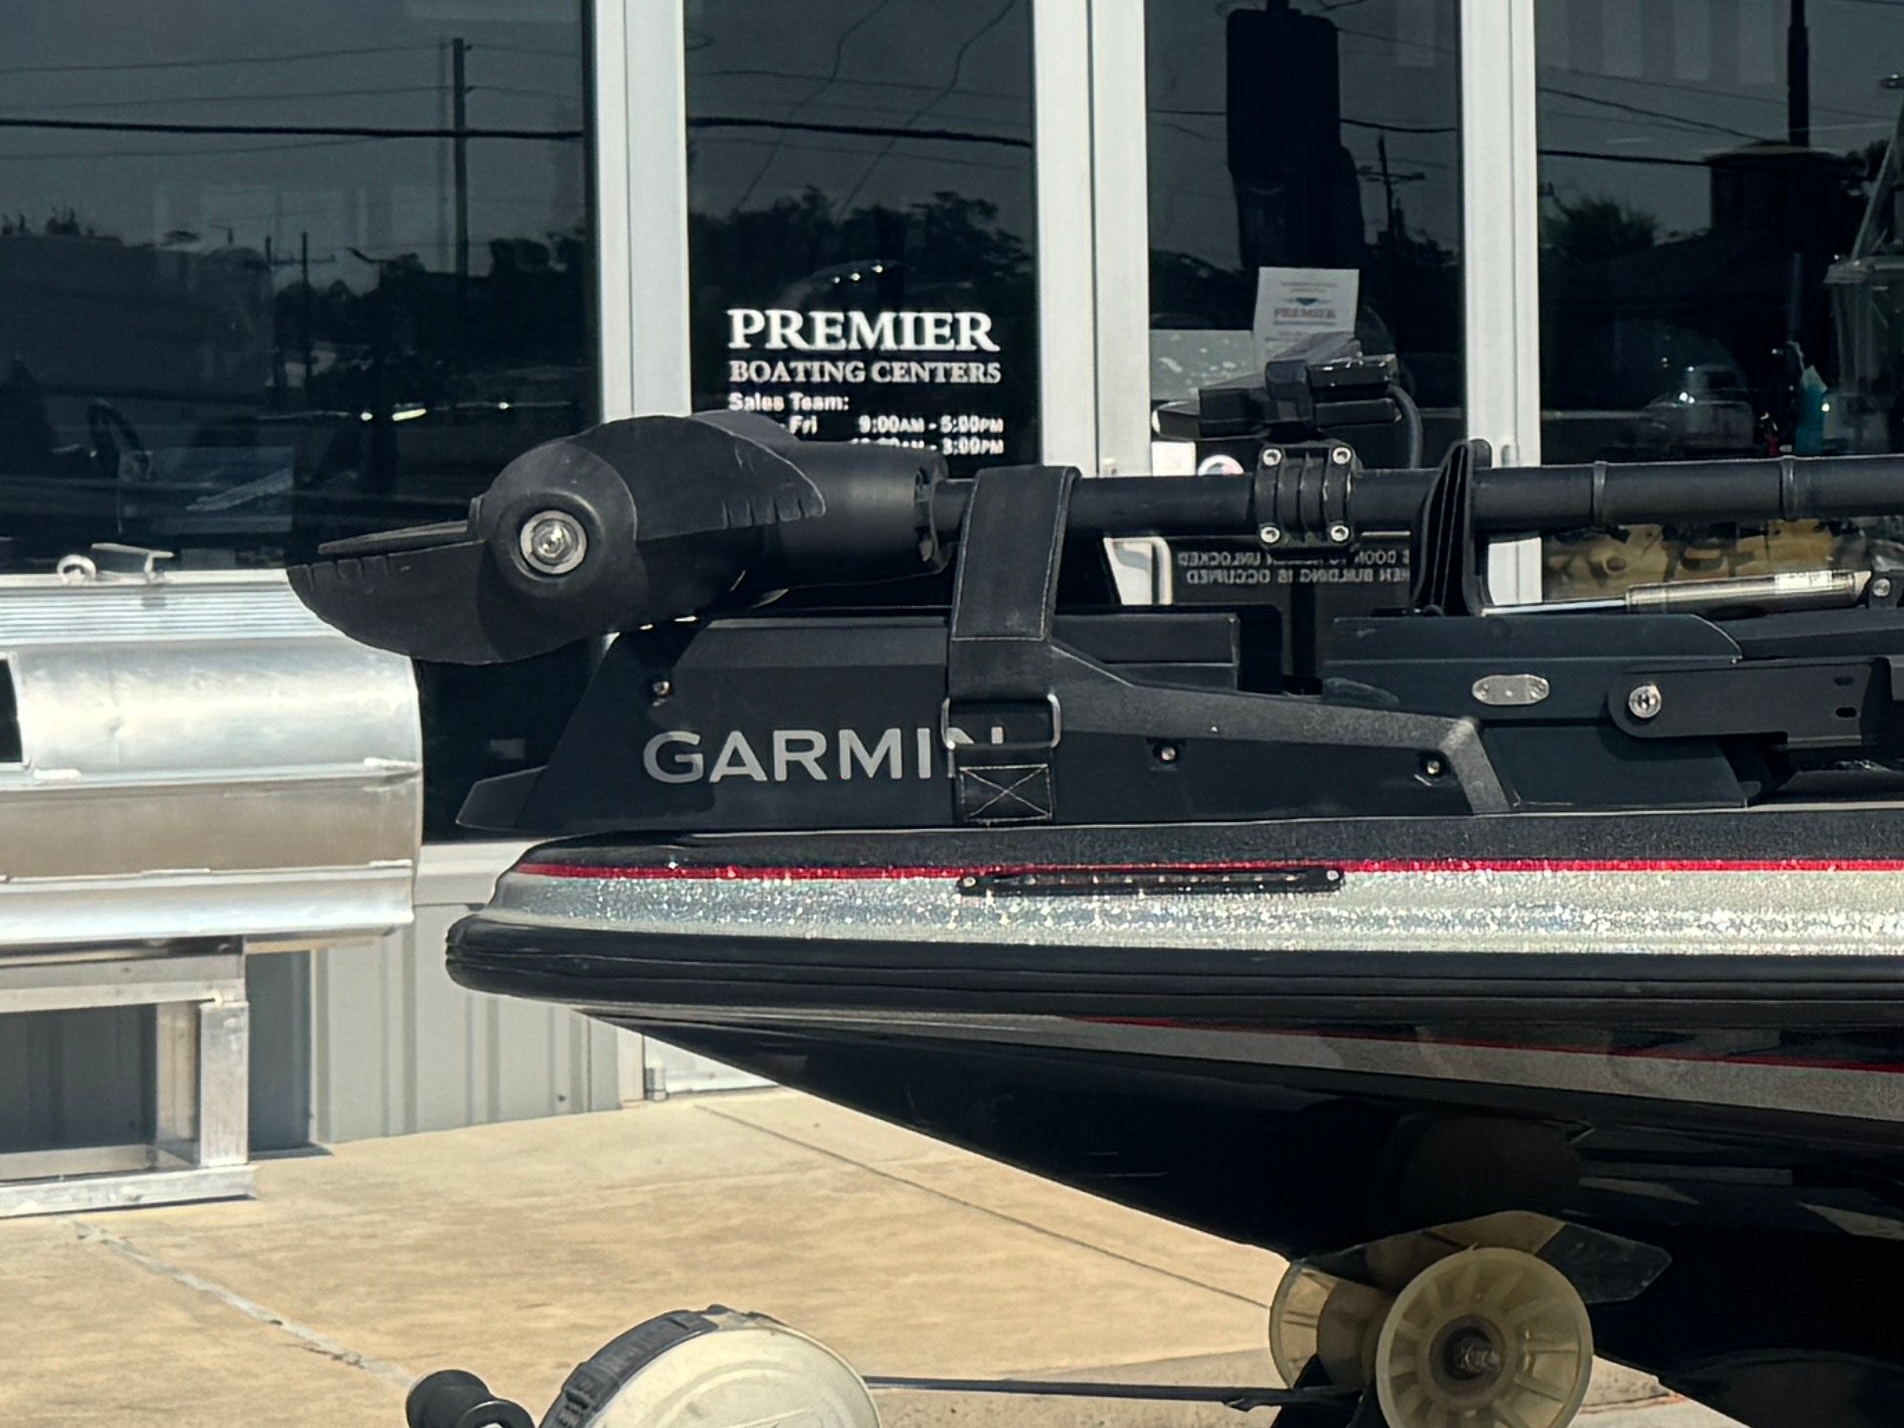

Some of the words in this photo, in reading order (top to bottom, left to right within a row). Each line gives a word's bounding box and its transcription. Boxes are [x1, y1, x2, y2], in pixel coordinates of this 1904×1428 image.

[726, 309, 1000, 352] PREMIER
[728, 360, 865, 383] BOATING
[871, 361, 1002, 383] CENTERS
[728, 391, 785, 412] Sales
[788, 391, 849, 411] Team:
[788, 414, 818, 434] Fri
[858, 414, 925, 434] 9:00AM
